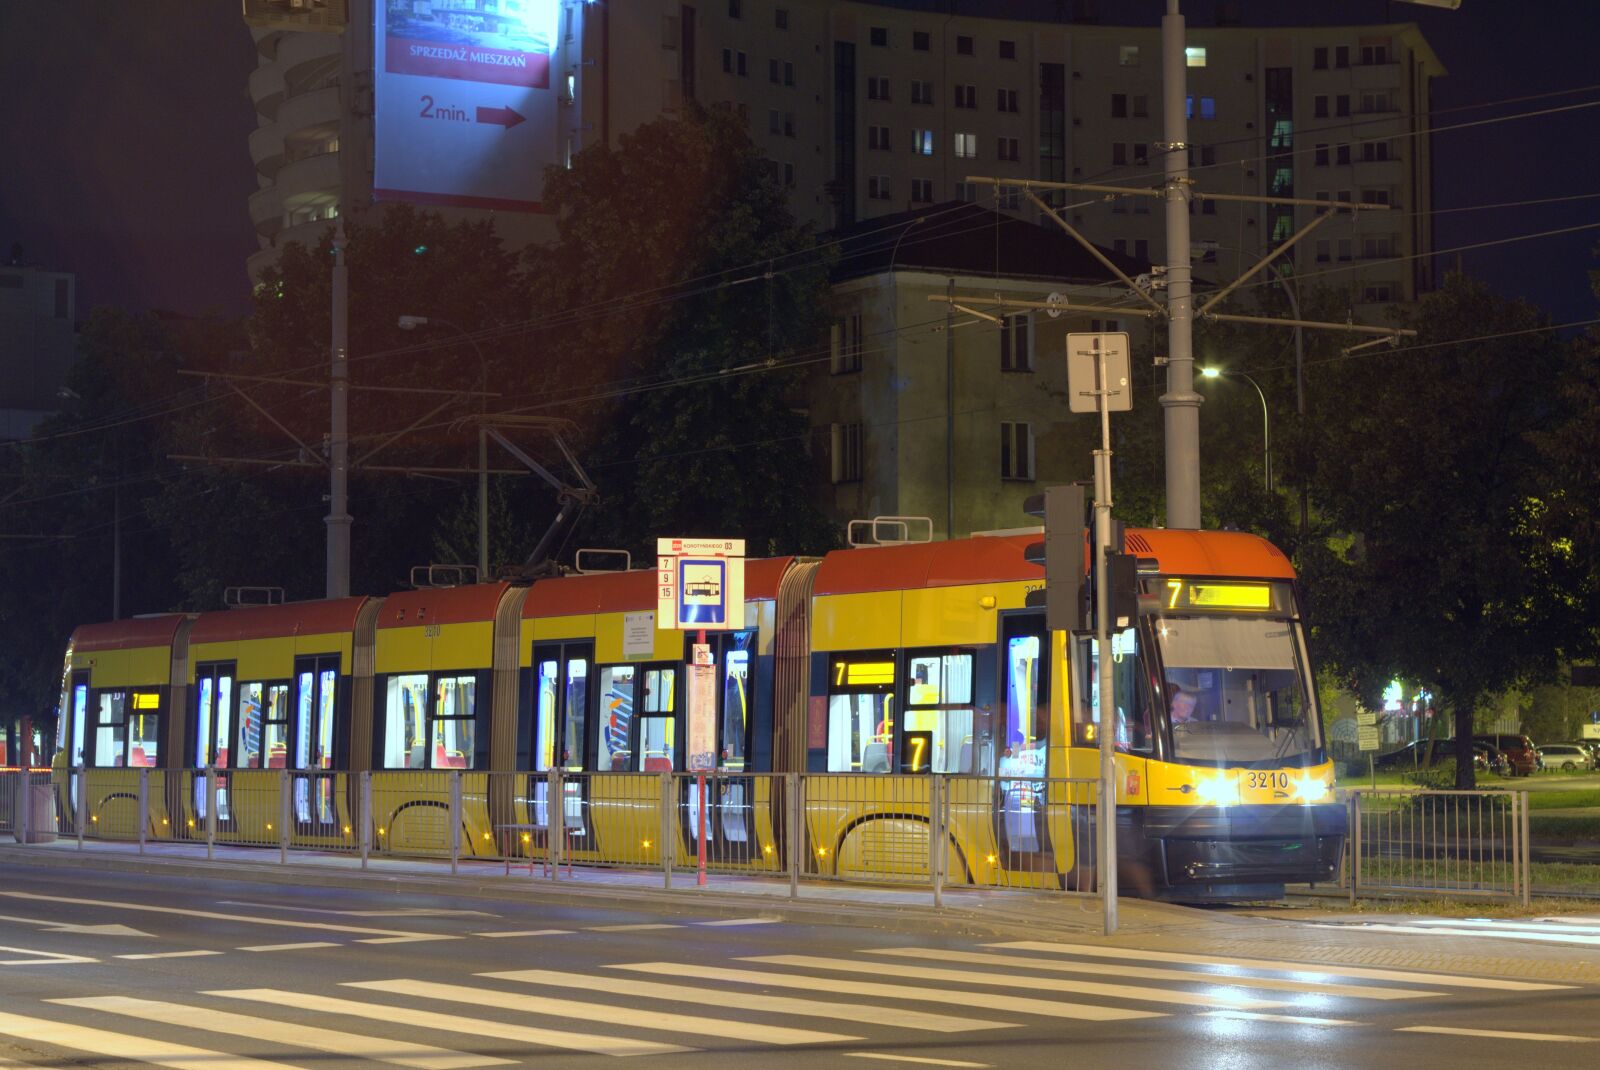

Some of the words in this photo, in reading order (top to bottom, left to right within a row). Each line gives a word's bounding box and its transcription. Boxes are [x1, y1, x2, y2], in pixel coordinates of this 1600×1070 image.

[410, 45, 466, 61] SPRZEDAŻ
[470, 51, 526, 68] MIESZKAŃ
[420, 95, 434, 118] 2
[436, 105, 470, 122] min.
[664, 559, 669, 568] 7
[664, 574, 668, 582] 9
[662, 588, 670, 597] 15
[1168, 581, 1182, 609] 7
[836, 662, 846, 686] 7
[133, 694, 138, 710] 7
[911, 738, 926, 772] 7
[1248, 772, 1288, 788] 3210
